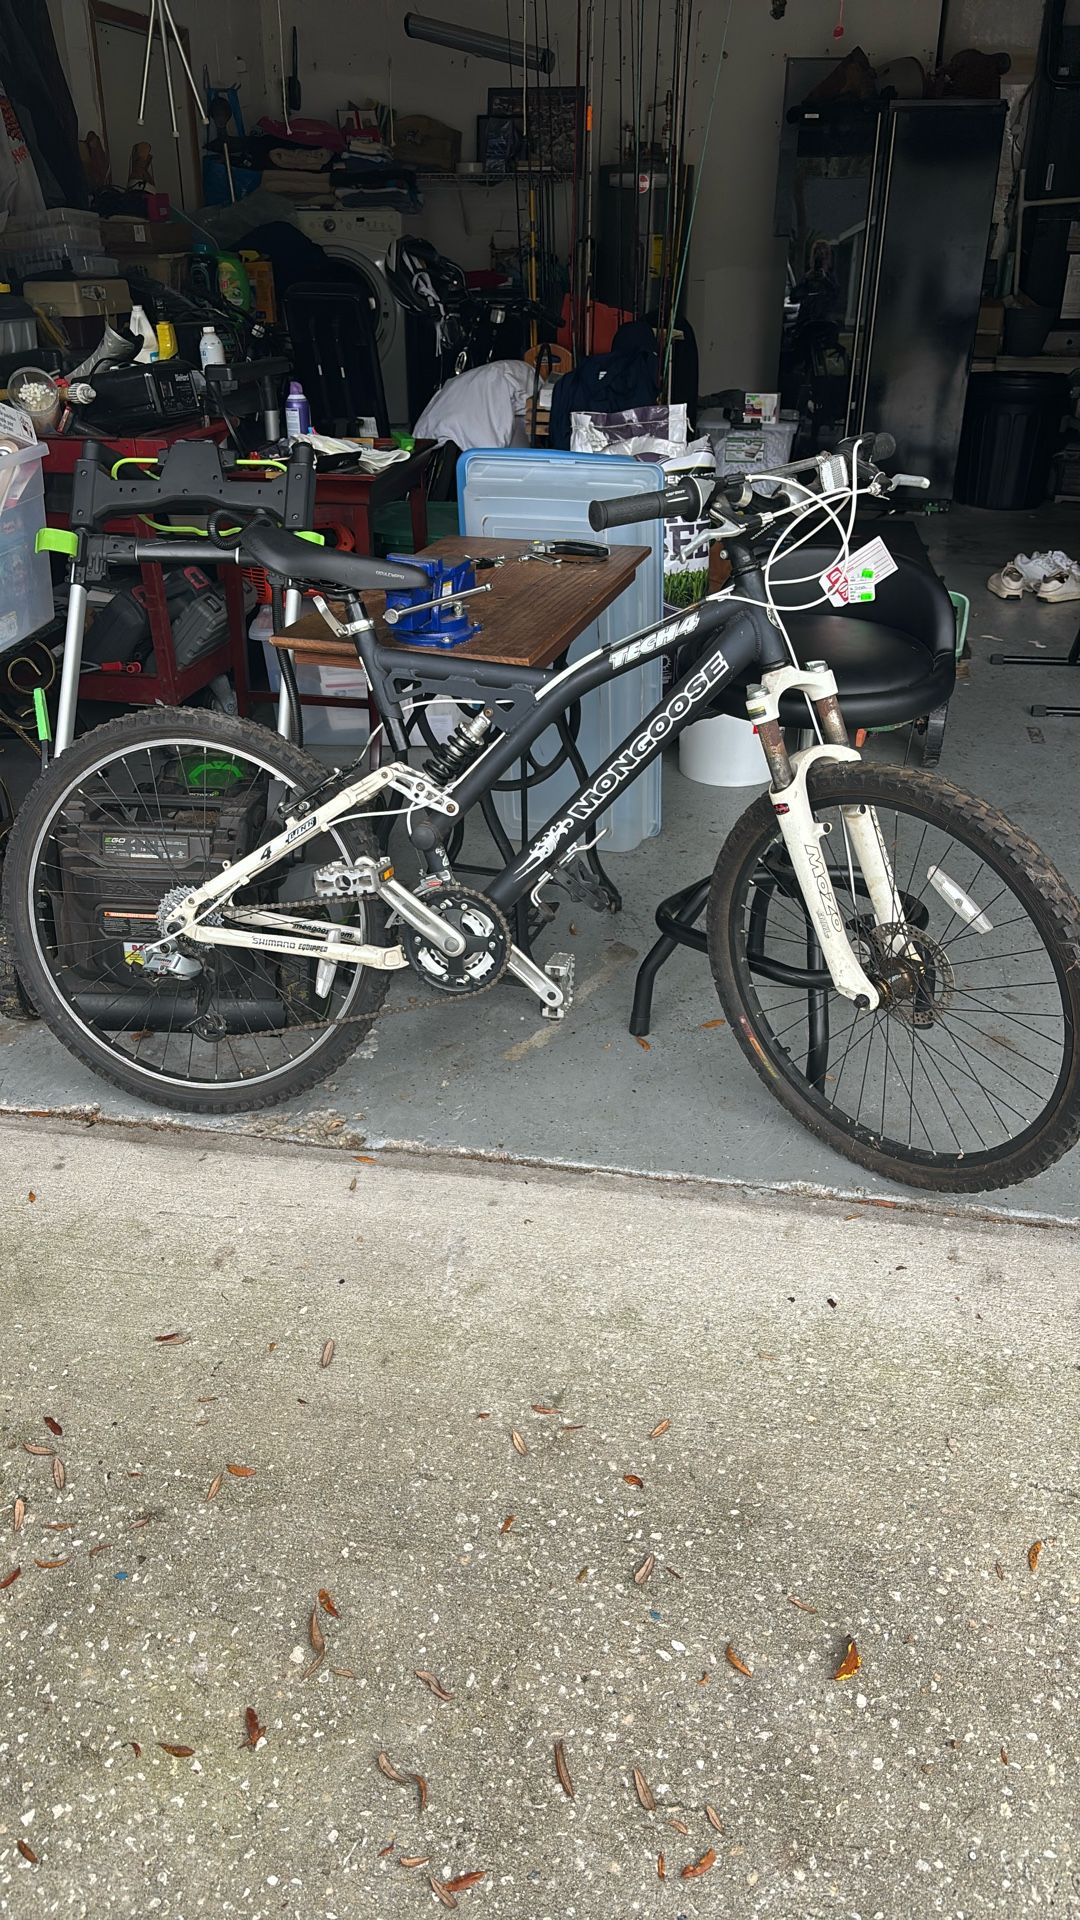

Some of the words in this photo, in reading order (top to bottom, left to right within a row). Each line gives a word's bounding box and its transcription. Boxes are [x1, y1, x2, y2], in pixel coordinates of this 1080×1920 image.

[567, 650, 730, 820] MONGOOSE
[804, 844, 843, 933] MOZO
[252, 936, 295, 949] SHIMANO
[298, 942, 328, 953] EQUIPPED
